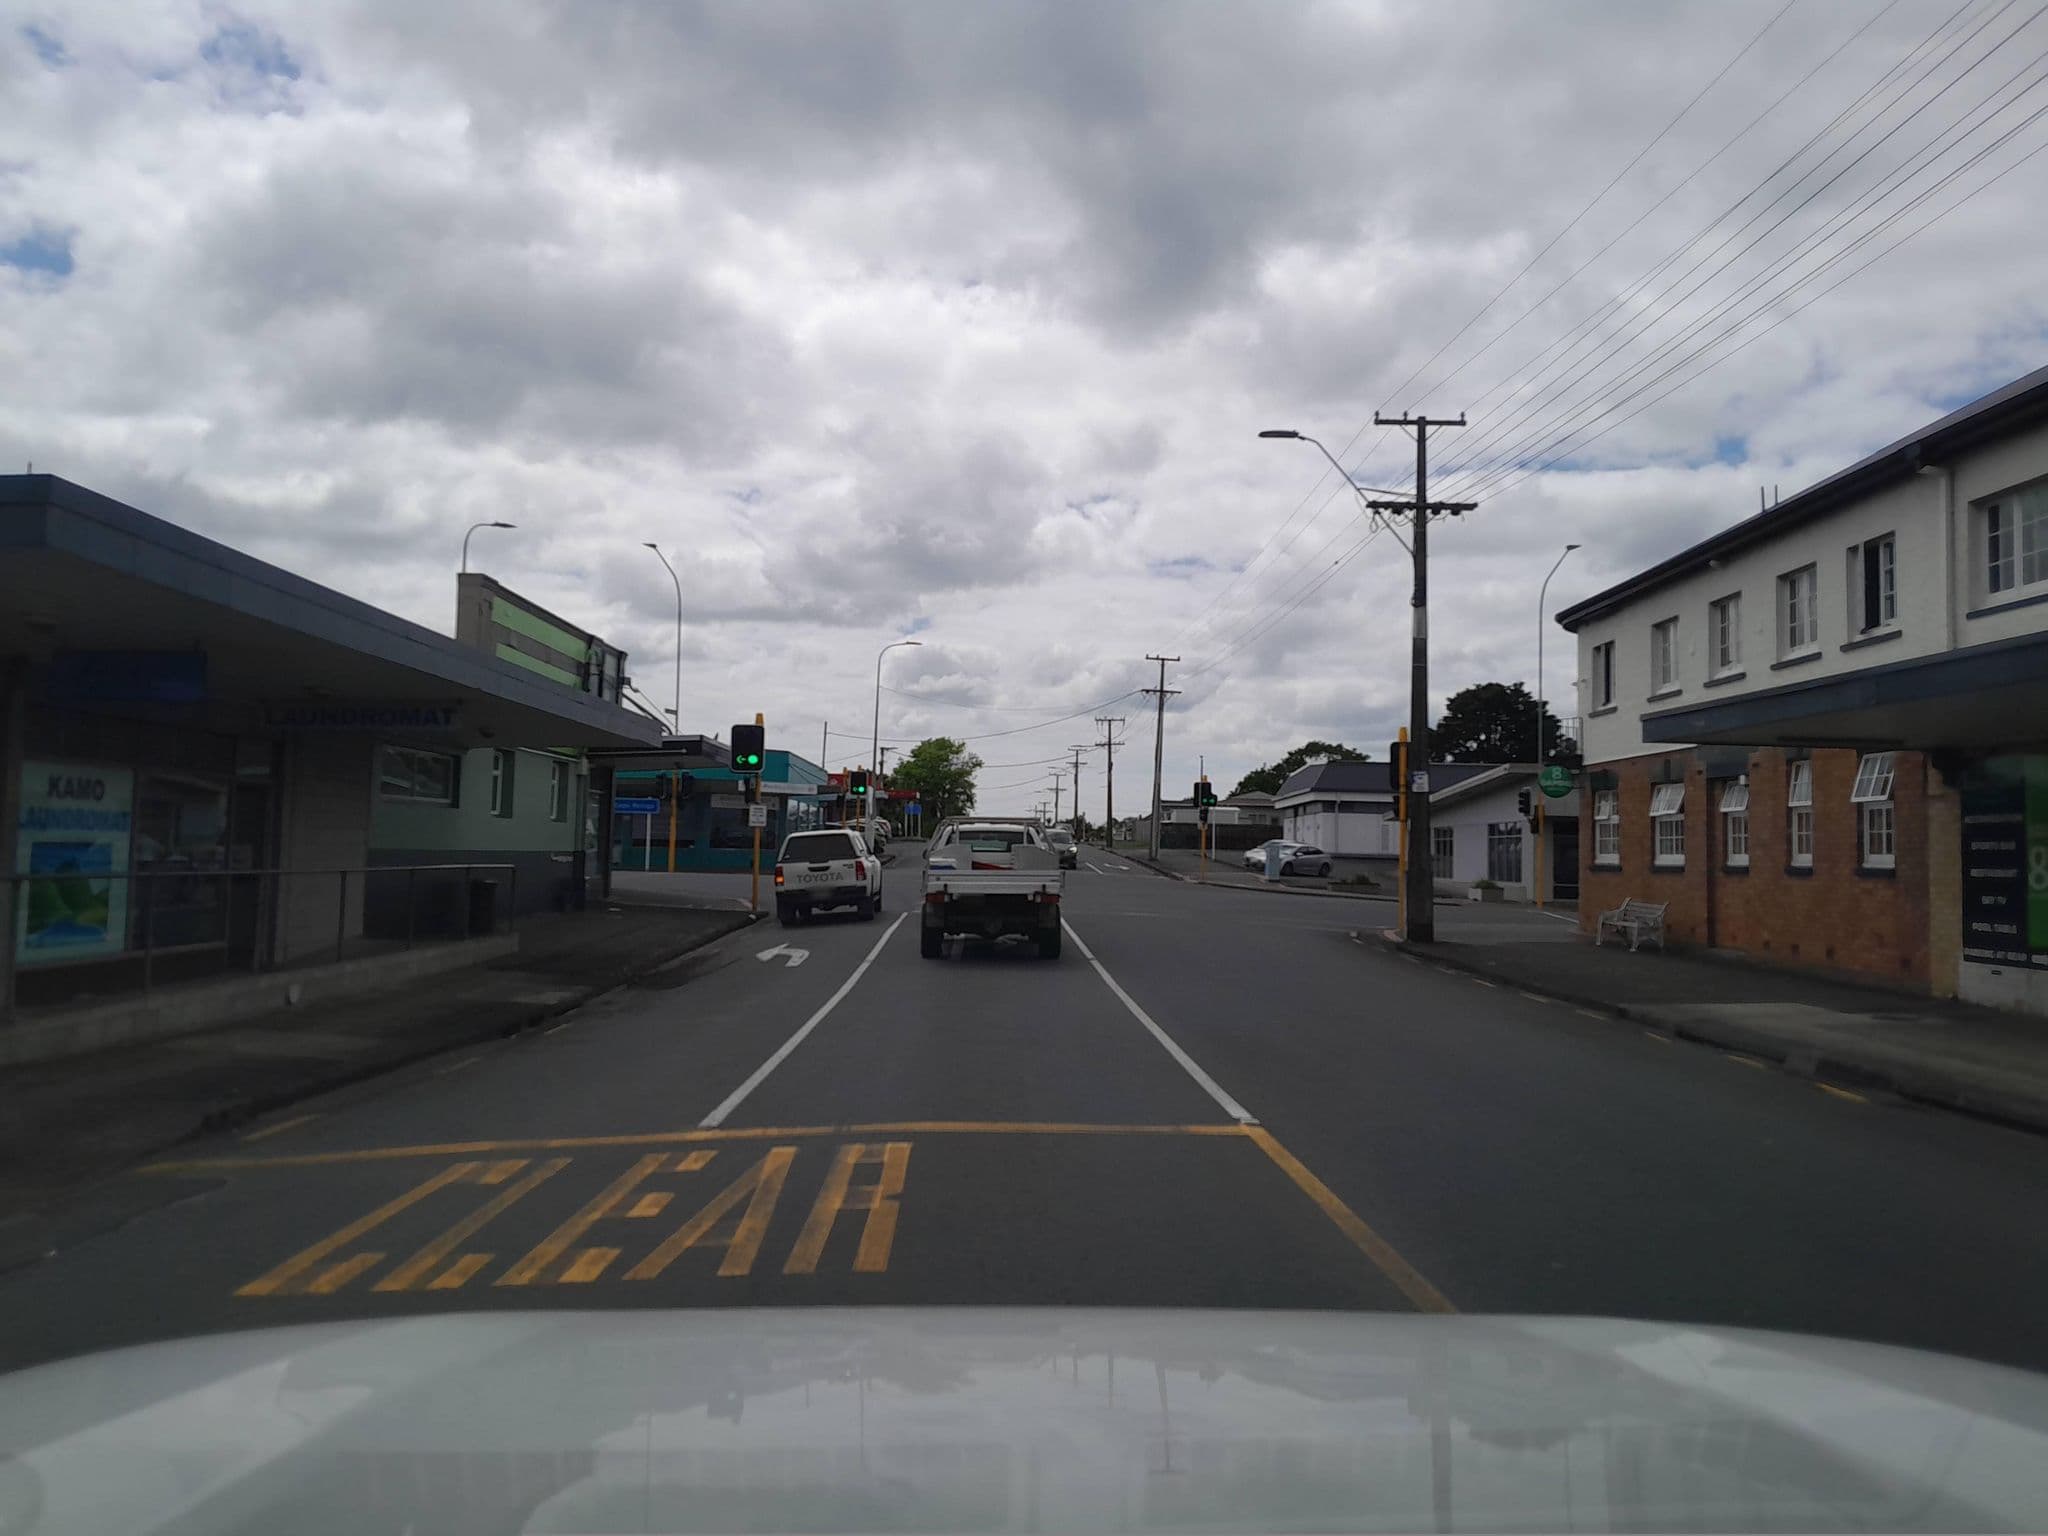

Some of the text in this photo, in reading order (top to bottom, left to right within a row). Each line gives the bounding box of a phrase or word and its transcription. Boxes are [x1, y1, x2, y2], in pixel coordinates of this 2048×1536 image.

[47, 775, 106, 802] KAMO
[796, 872, 844, 884] TOYOTA
[235, 1141, 913, 1295] CLEAR
